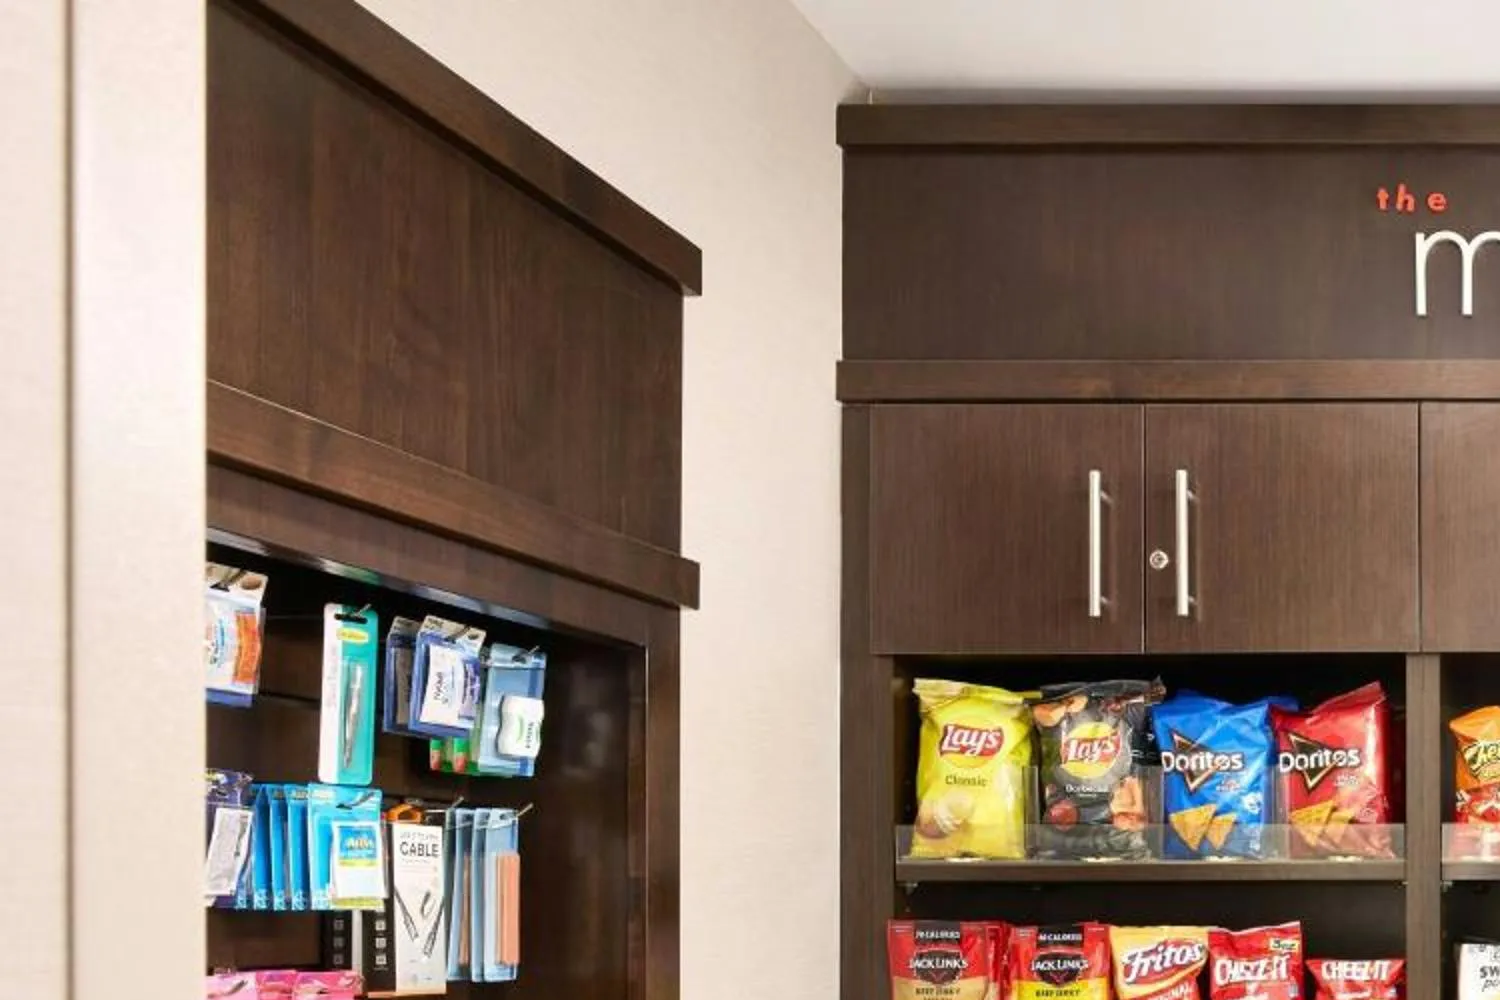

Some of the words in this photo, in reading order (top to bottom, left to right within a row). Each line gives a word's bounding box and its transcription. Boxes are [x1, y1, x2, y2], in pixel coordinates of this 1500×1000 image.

[1376, 184, 1448, 212] the
[1161, 751, 1244, 772] Doritos
[1279, 748, 1361, 772] Doritos
[399, 841, 440, 857] CABLE
[1121, 942, 1205, 984] Fritos
